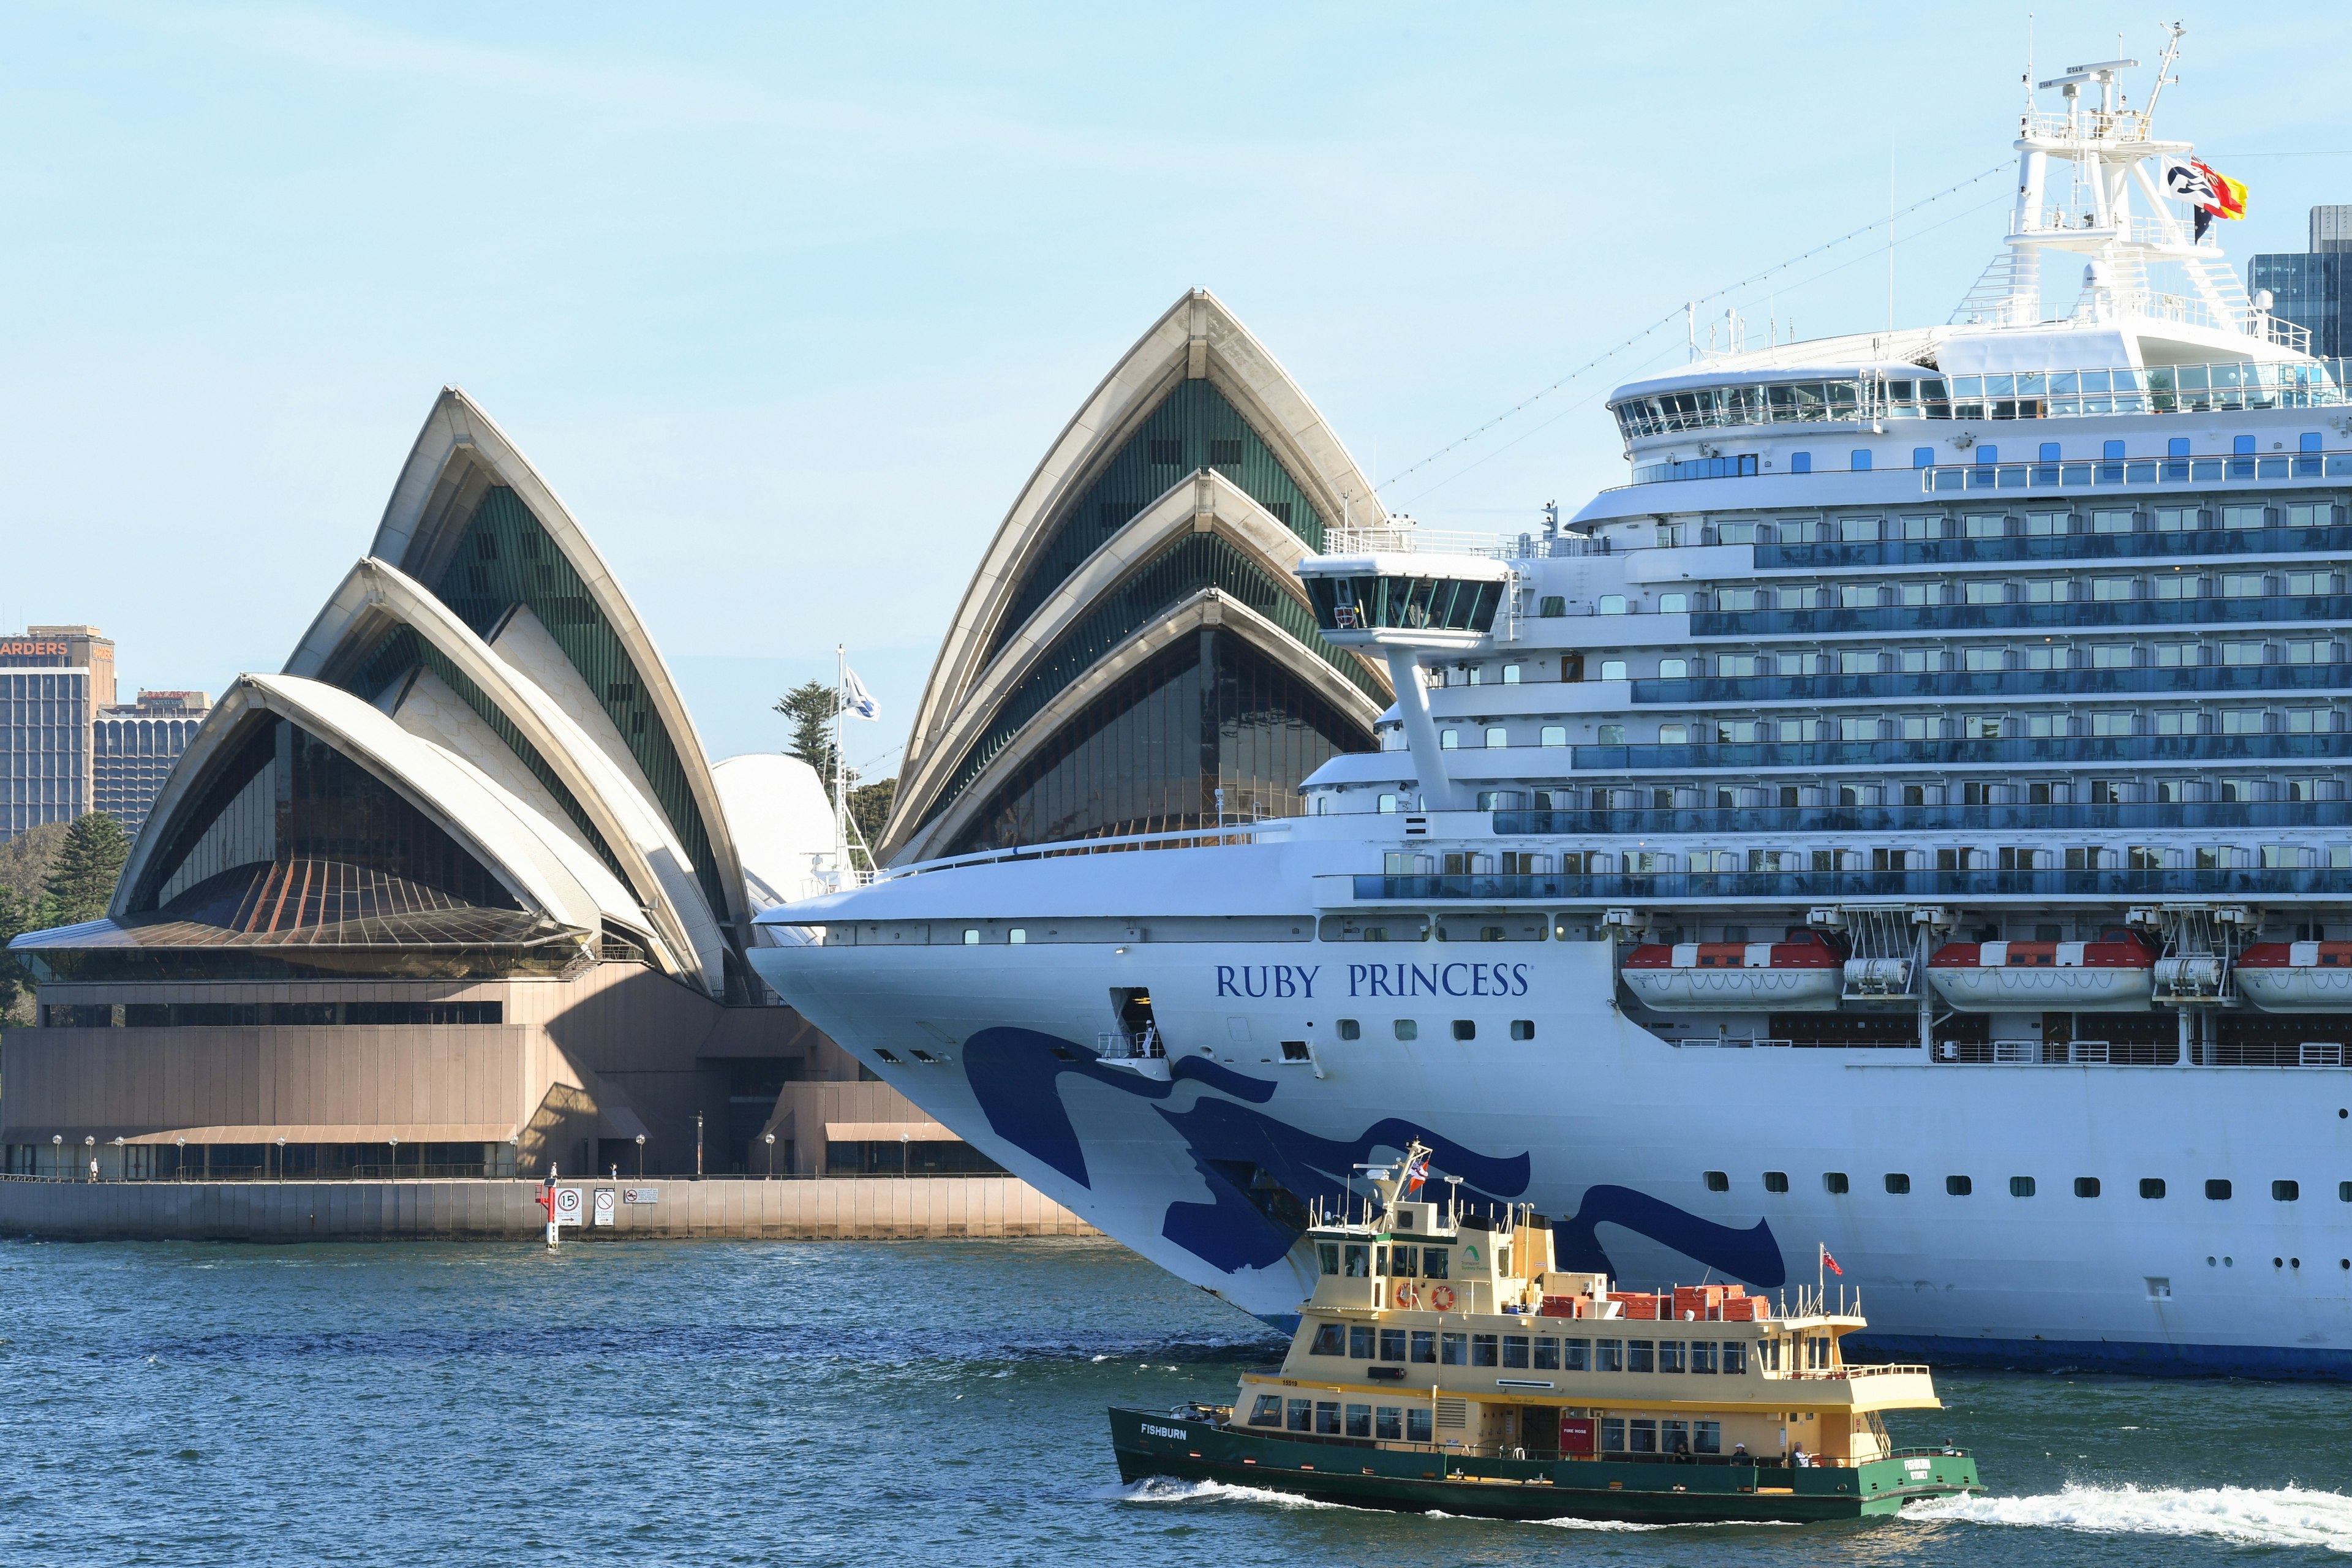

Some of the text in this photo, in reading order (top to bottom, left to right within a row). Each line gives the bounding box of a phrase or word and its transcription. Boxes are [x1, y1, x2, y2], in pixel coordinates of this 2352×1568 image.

[0, 642, 68, 655] ARDERS
[93, 645, 113, 660] HARDERS
[1214, 962, 1528, 998] RUBY PRINCESS
[562, 1195, 575, 1207] 15
[1141, 1423, 1187, 1441] FISHBURN
[1904, 1458, 1931, 1471] FISHBURN
